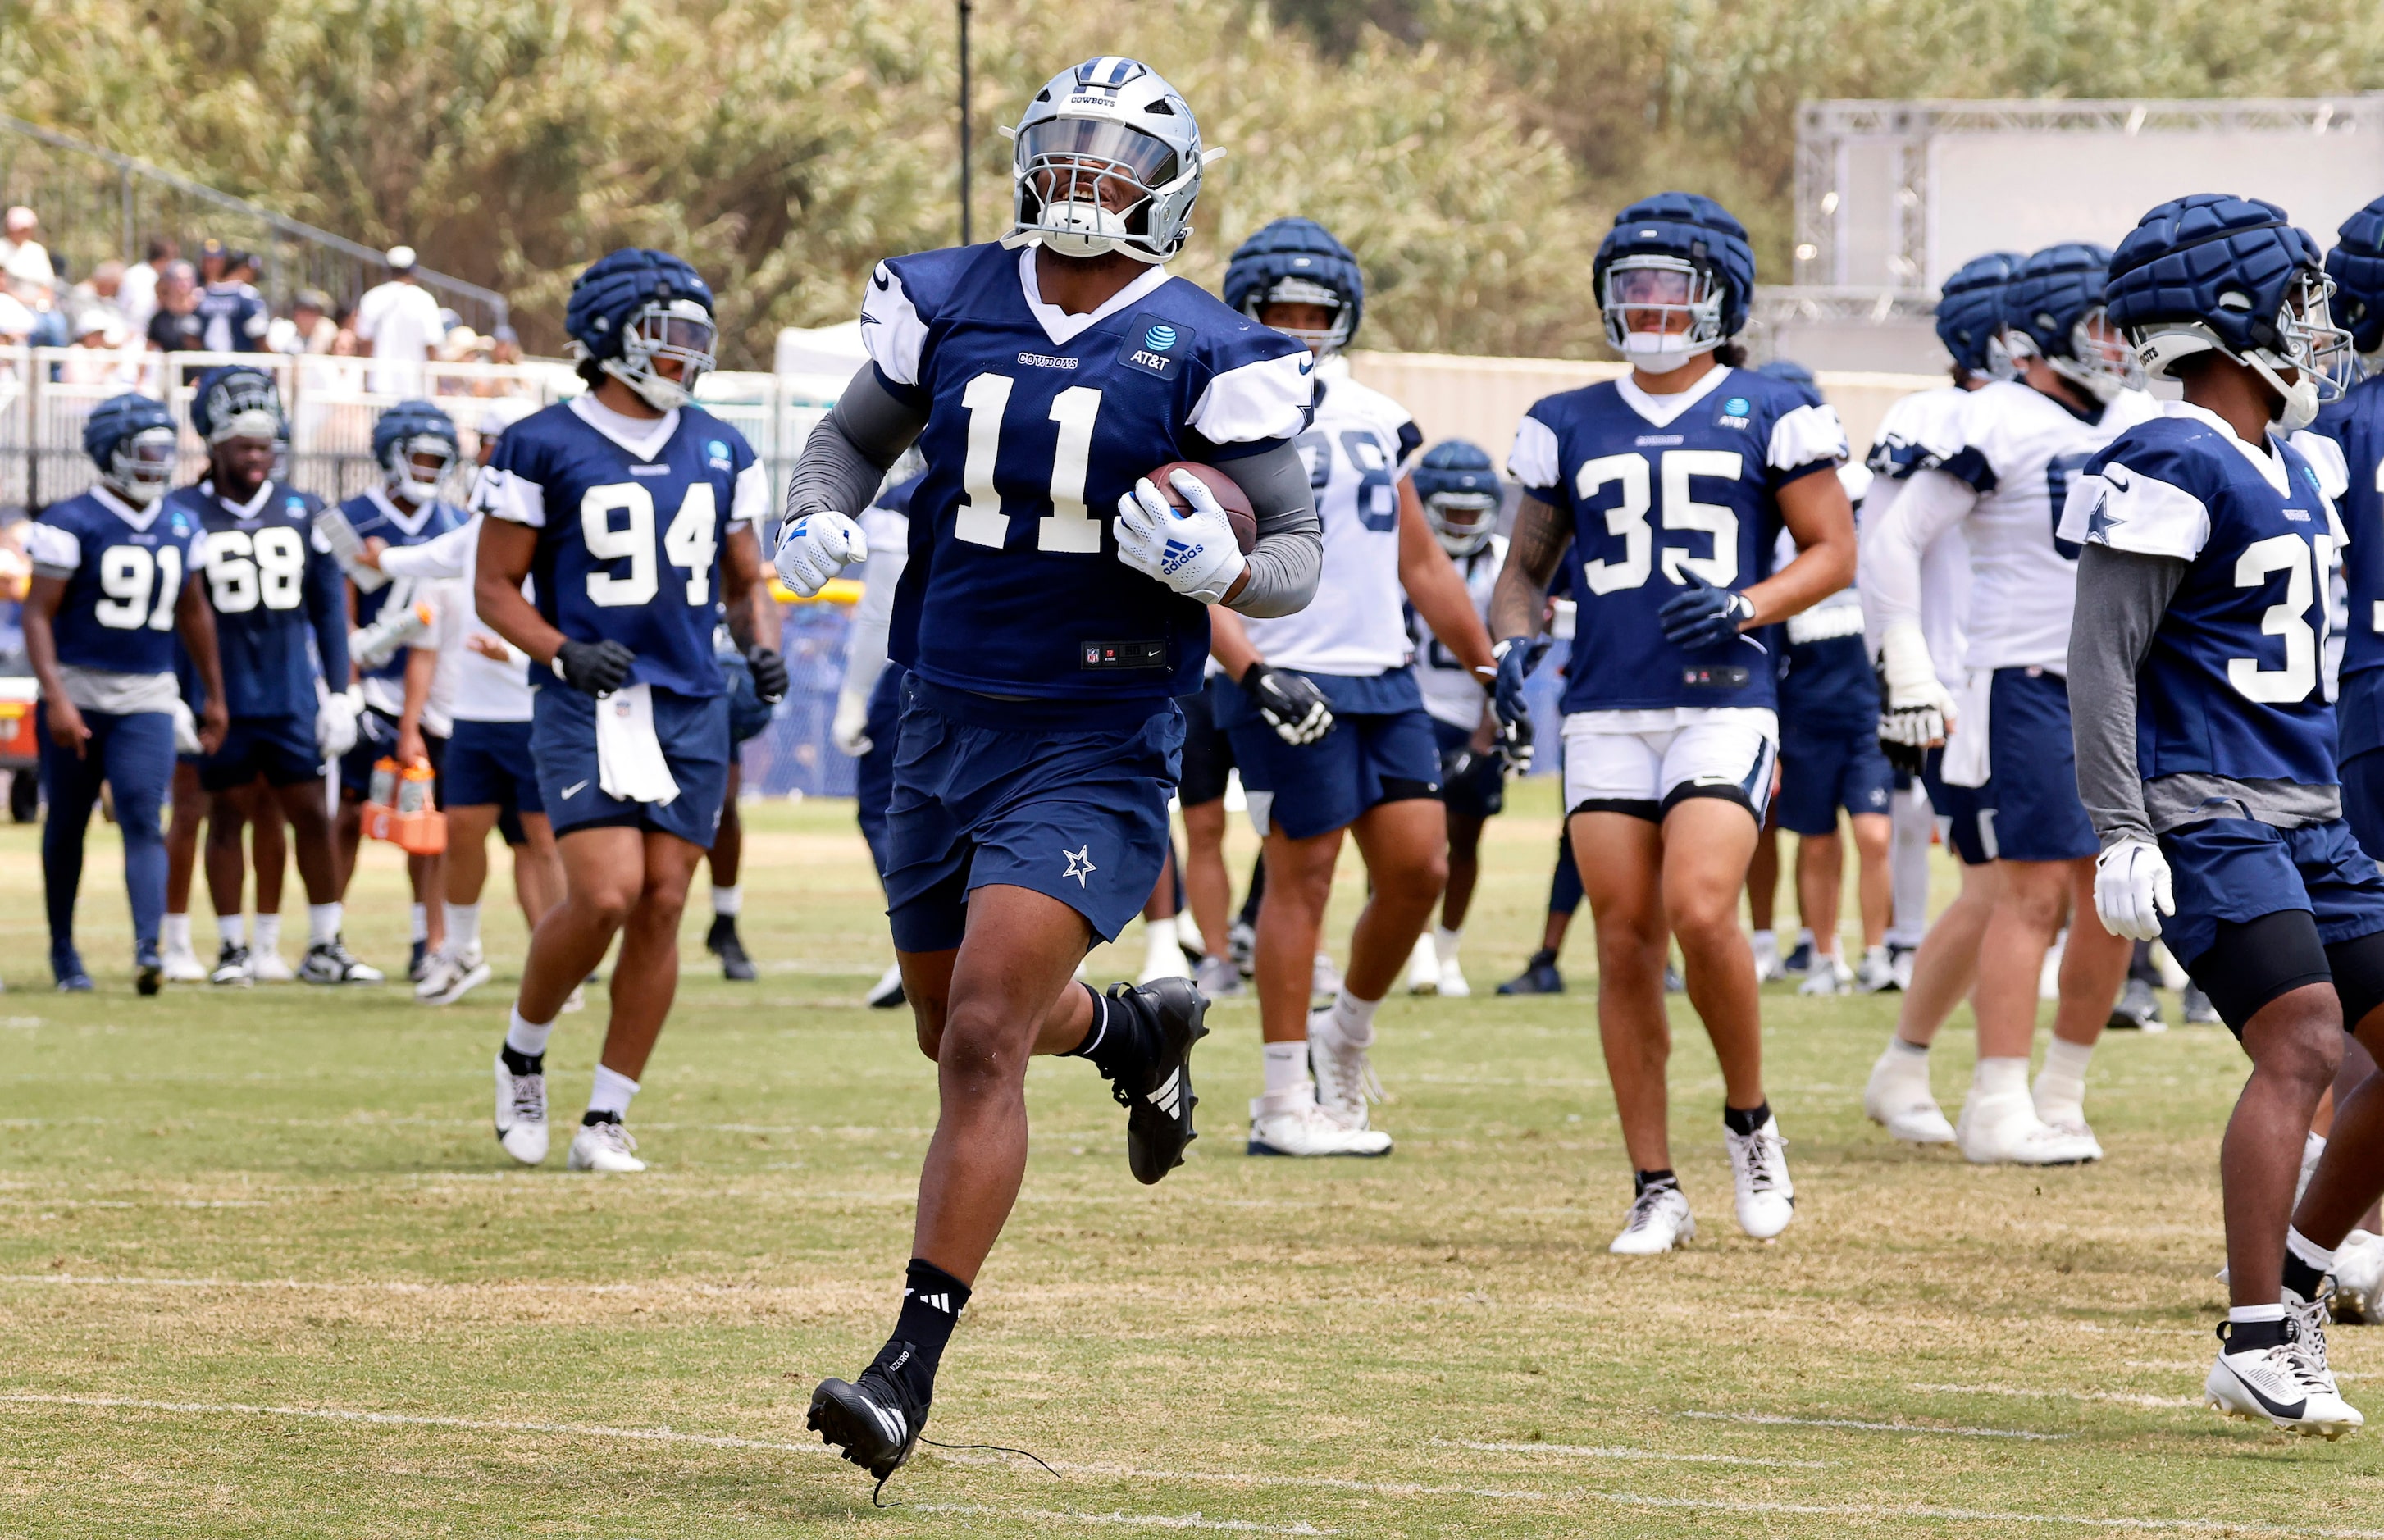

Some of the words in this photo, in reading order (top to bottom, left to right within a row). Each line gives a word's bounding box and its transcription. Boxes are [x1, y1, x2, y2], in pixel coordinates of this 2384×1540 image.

[1071, 97, 1116, 107] COWBOYS
[1018, 352, 1078, 369] COWBOYS
[1130, 350, 1170, 371] AT&T
[954, 371, 1102, 554] 11
[581, 481, 718, 608] 94
[1163, 544, 1204, 575] adidas
[1576, 450, 1743, 596] 35
[95, 544, 182, 631] 91
[204, 526, 305, 613] 68
